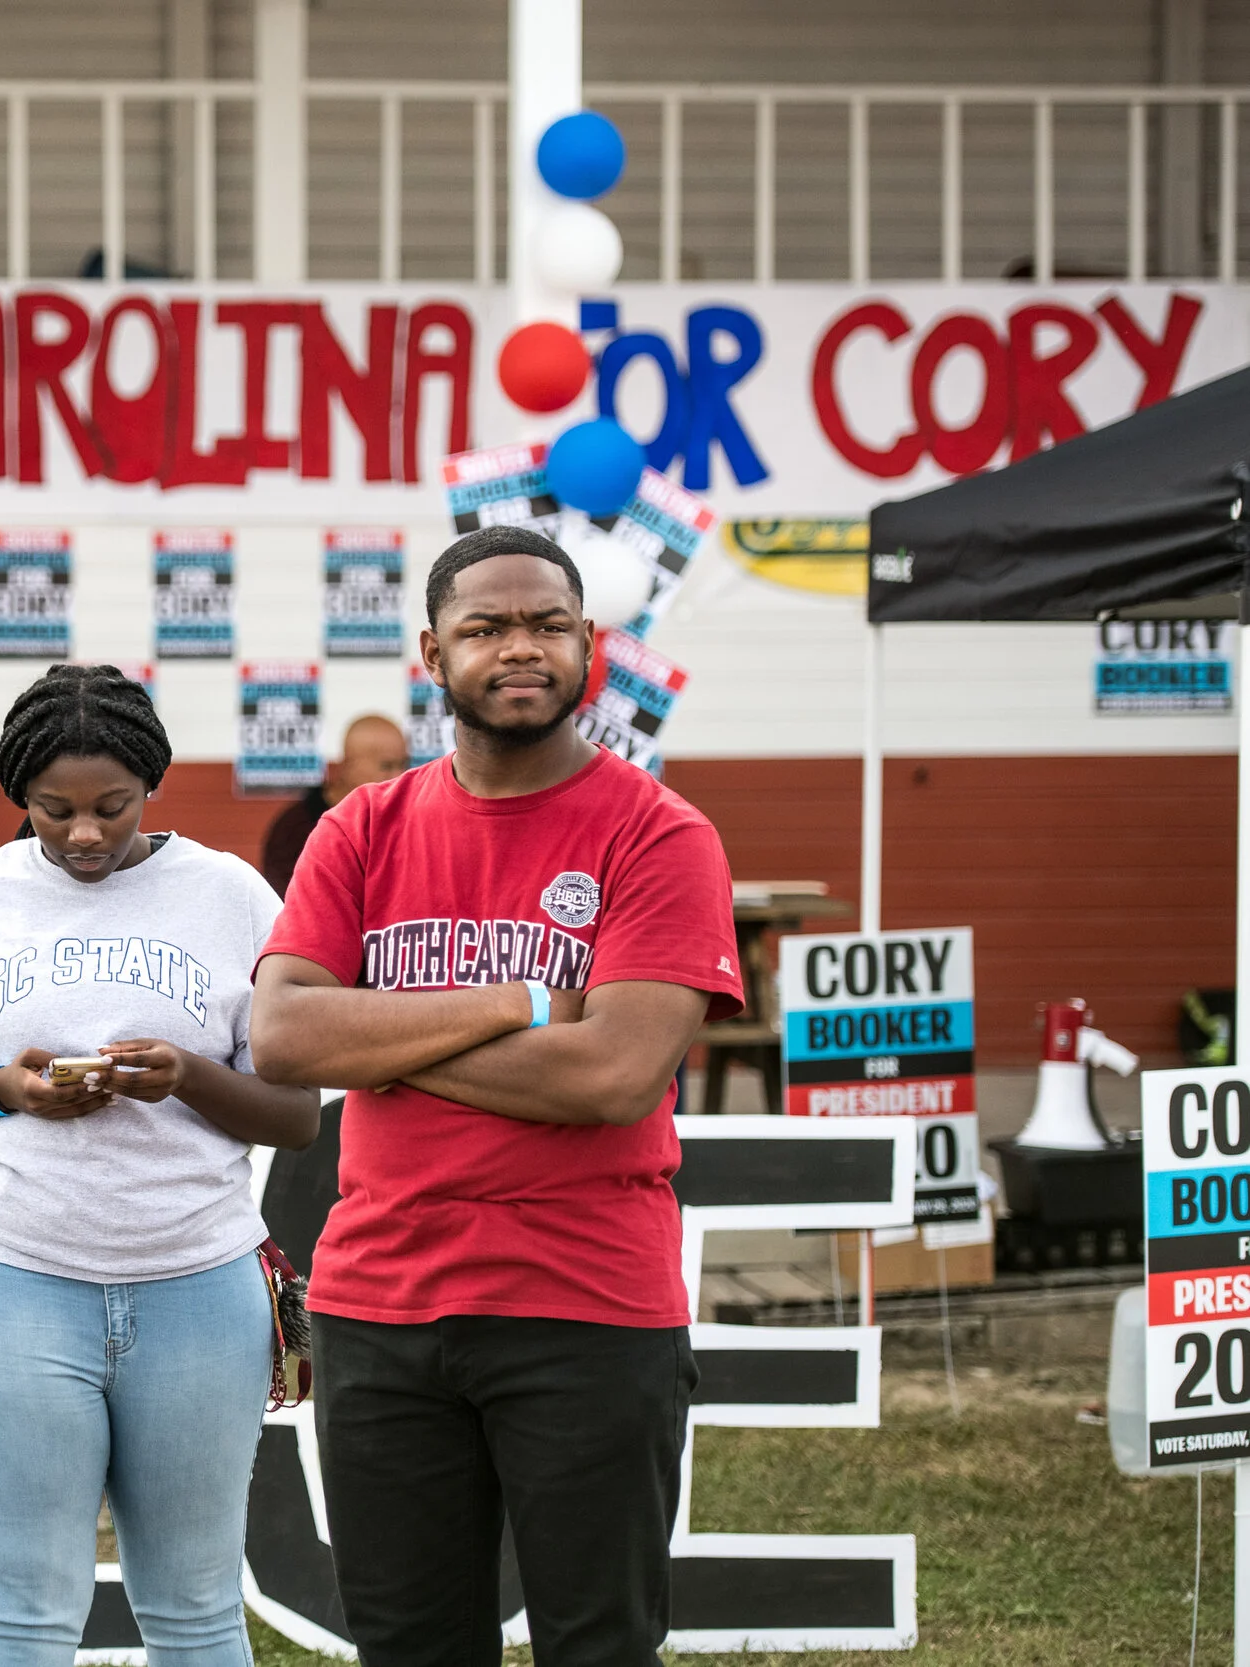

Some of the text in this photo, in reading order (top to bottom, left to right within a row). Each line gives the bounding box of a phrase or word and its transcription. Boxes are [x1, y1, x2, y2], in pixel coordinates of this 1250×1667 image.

[812, 292, 1203, 480] CORY
[555, 888, 591, 906] HBCU
[362, 918, 452, 990] OUTH
[806, 938, 954, 1000] CORY
[51, 936, 211, 1028] STATE
[807, 1008, 954, 1052] BOOKER
[863, 1056, 901, 1080] FOR
[807, 1079, 957, 1117] PRESIDENT
[1155, 1430, 1250, 1456] VOTE SATURDAY,
